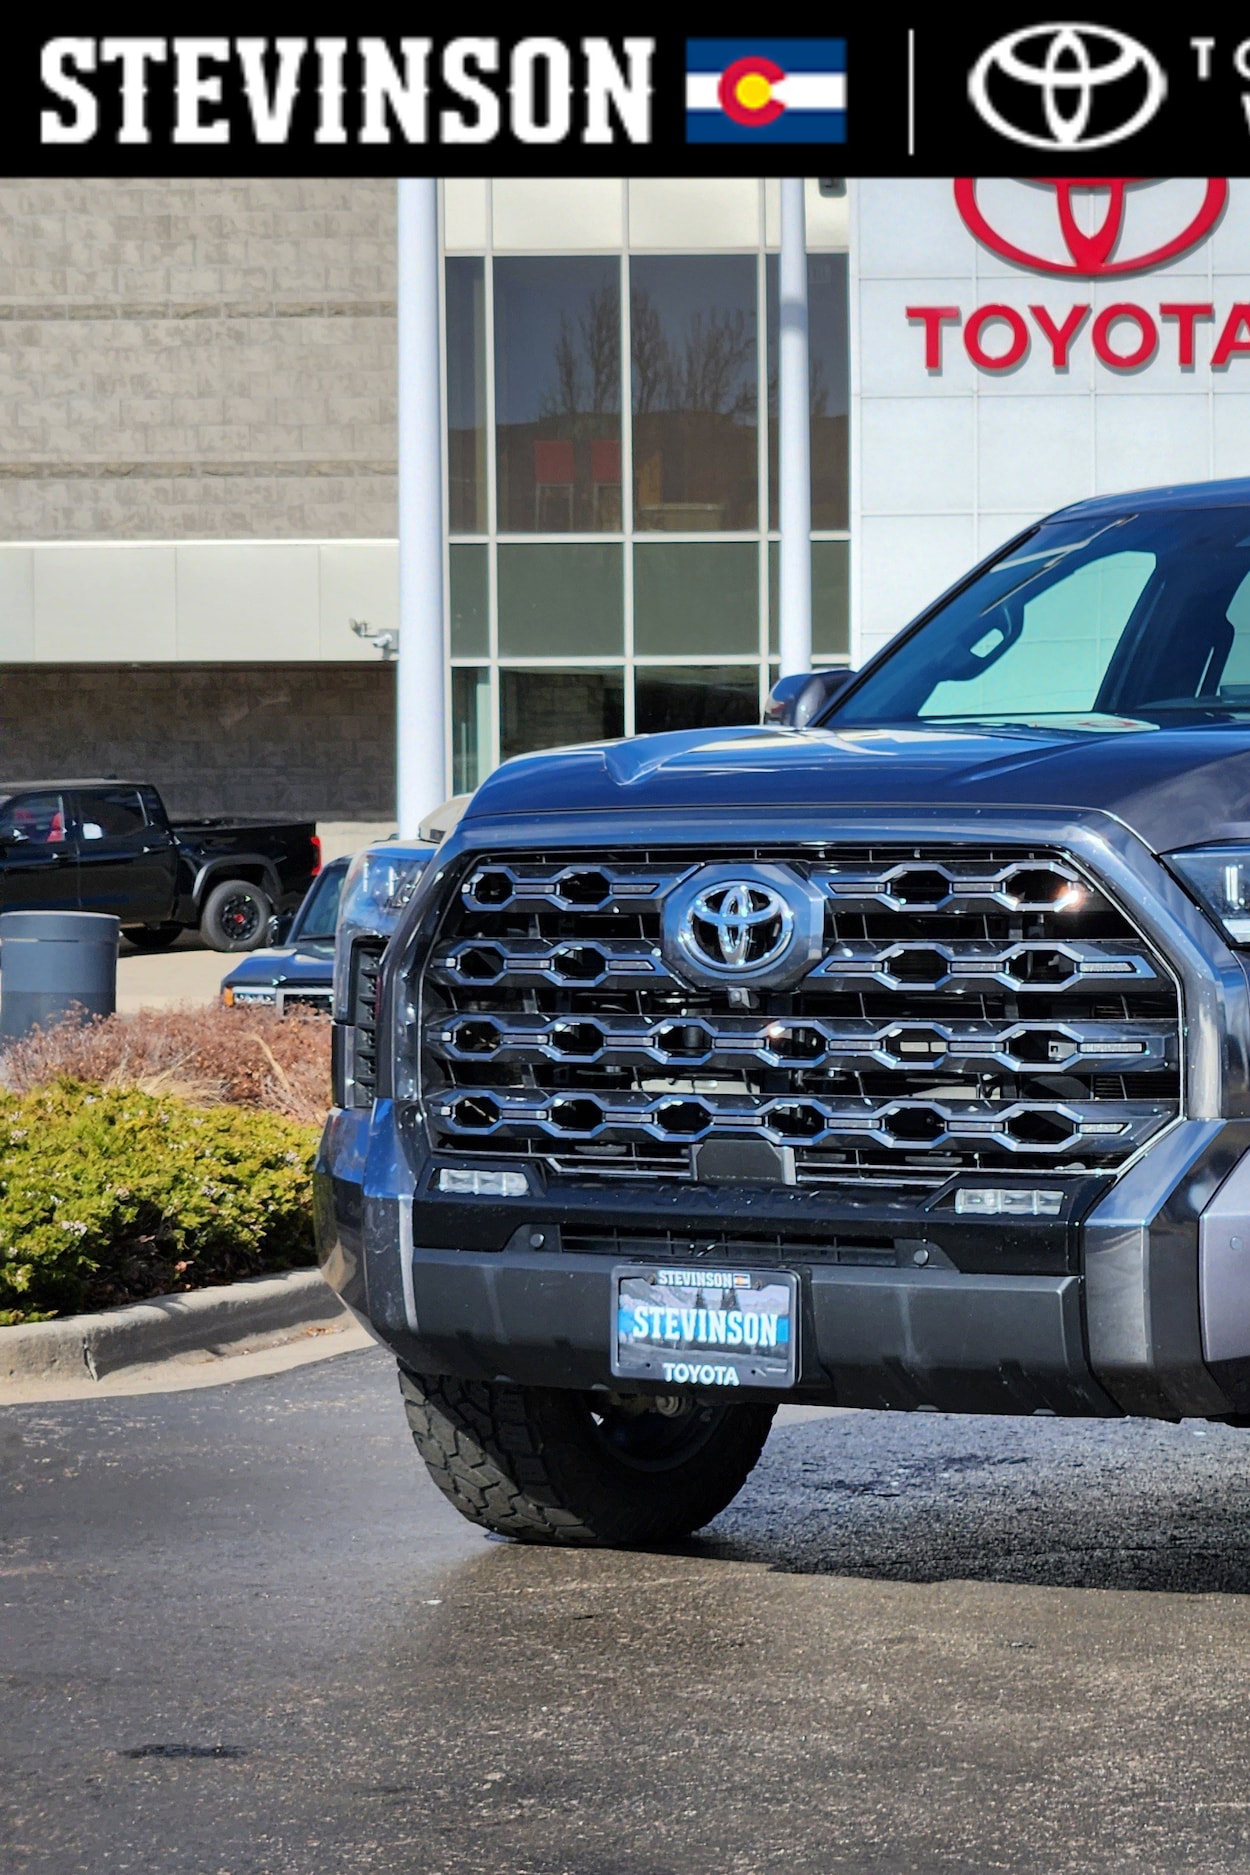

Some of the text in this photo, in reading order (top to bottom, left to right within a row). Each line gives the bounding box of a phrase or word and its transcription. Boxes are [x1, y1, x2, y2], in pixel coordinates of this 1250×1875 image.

[657, 1269, 733, 1288] STEVINSON
[632, 1306, 779, 1347] STEVINSON
[662, 1362, 740, 1387] TOYOTA
